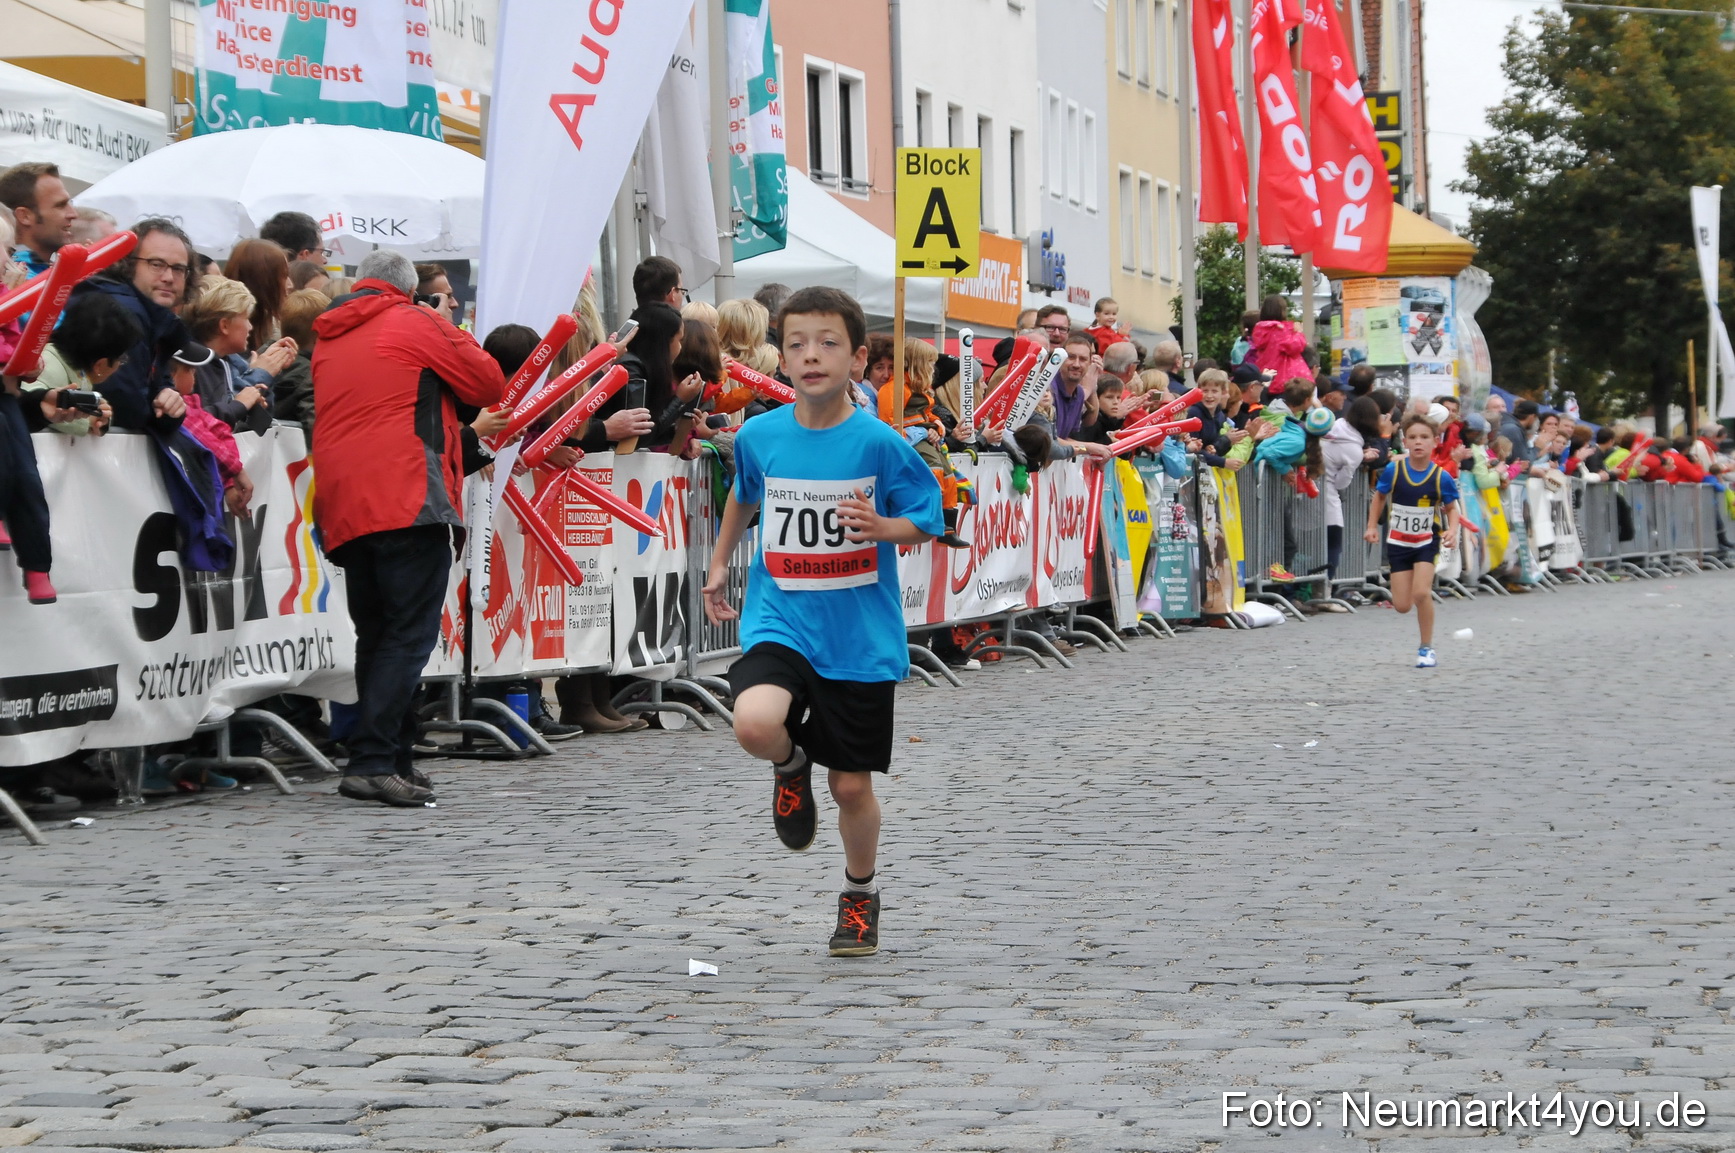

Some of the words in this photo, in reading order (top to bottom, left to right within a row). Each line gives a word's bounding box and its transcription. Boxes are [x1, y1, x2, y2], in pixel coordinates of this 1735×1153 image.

[95, 123, 123, 161] Audi
[126, 133, 151, 163] BKK
[906, 152, 971, 177] Block
[351, 216, 409, 237] BKK
[912, 187, 961, 249] A
[498, 388, 518, 410] Audi
[513, 369, 533, 390] BKK
[1032, 369, 1052, 396] BMW
[513, 398, 538, 420] Audi
[535, 381, 559, 400] BKK
[542, 433, 564, 456] Audi
[562, 415, 582, 435] BKK
[767, 488, 801, 501] PARTL
[803, 491, 859, 502] Neumark
[774, 506, 866, 548] 709
[1394, 515, 1430, 533] 7184
[783, 558, 859, 575] Sebastian
[486, 592, 515, 641] Braun
[568, 618, 580, 630] Fax
[37, 691, 57, 715] die
[58, 685, 113, 712] verbinden
